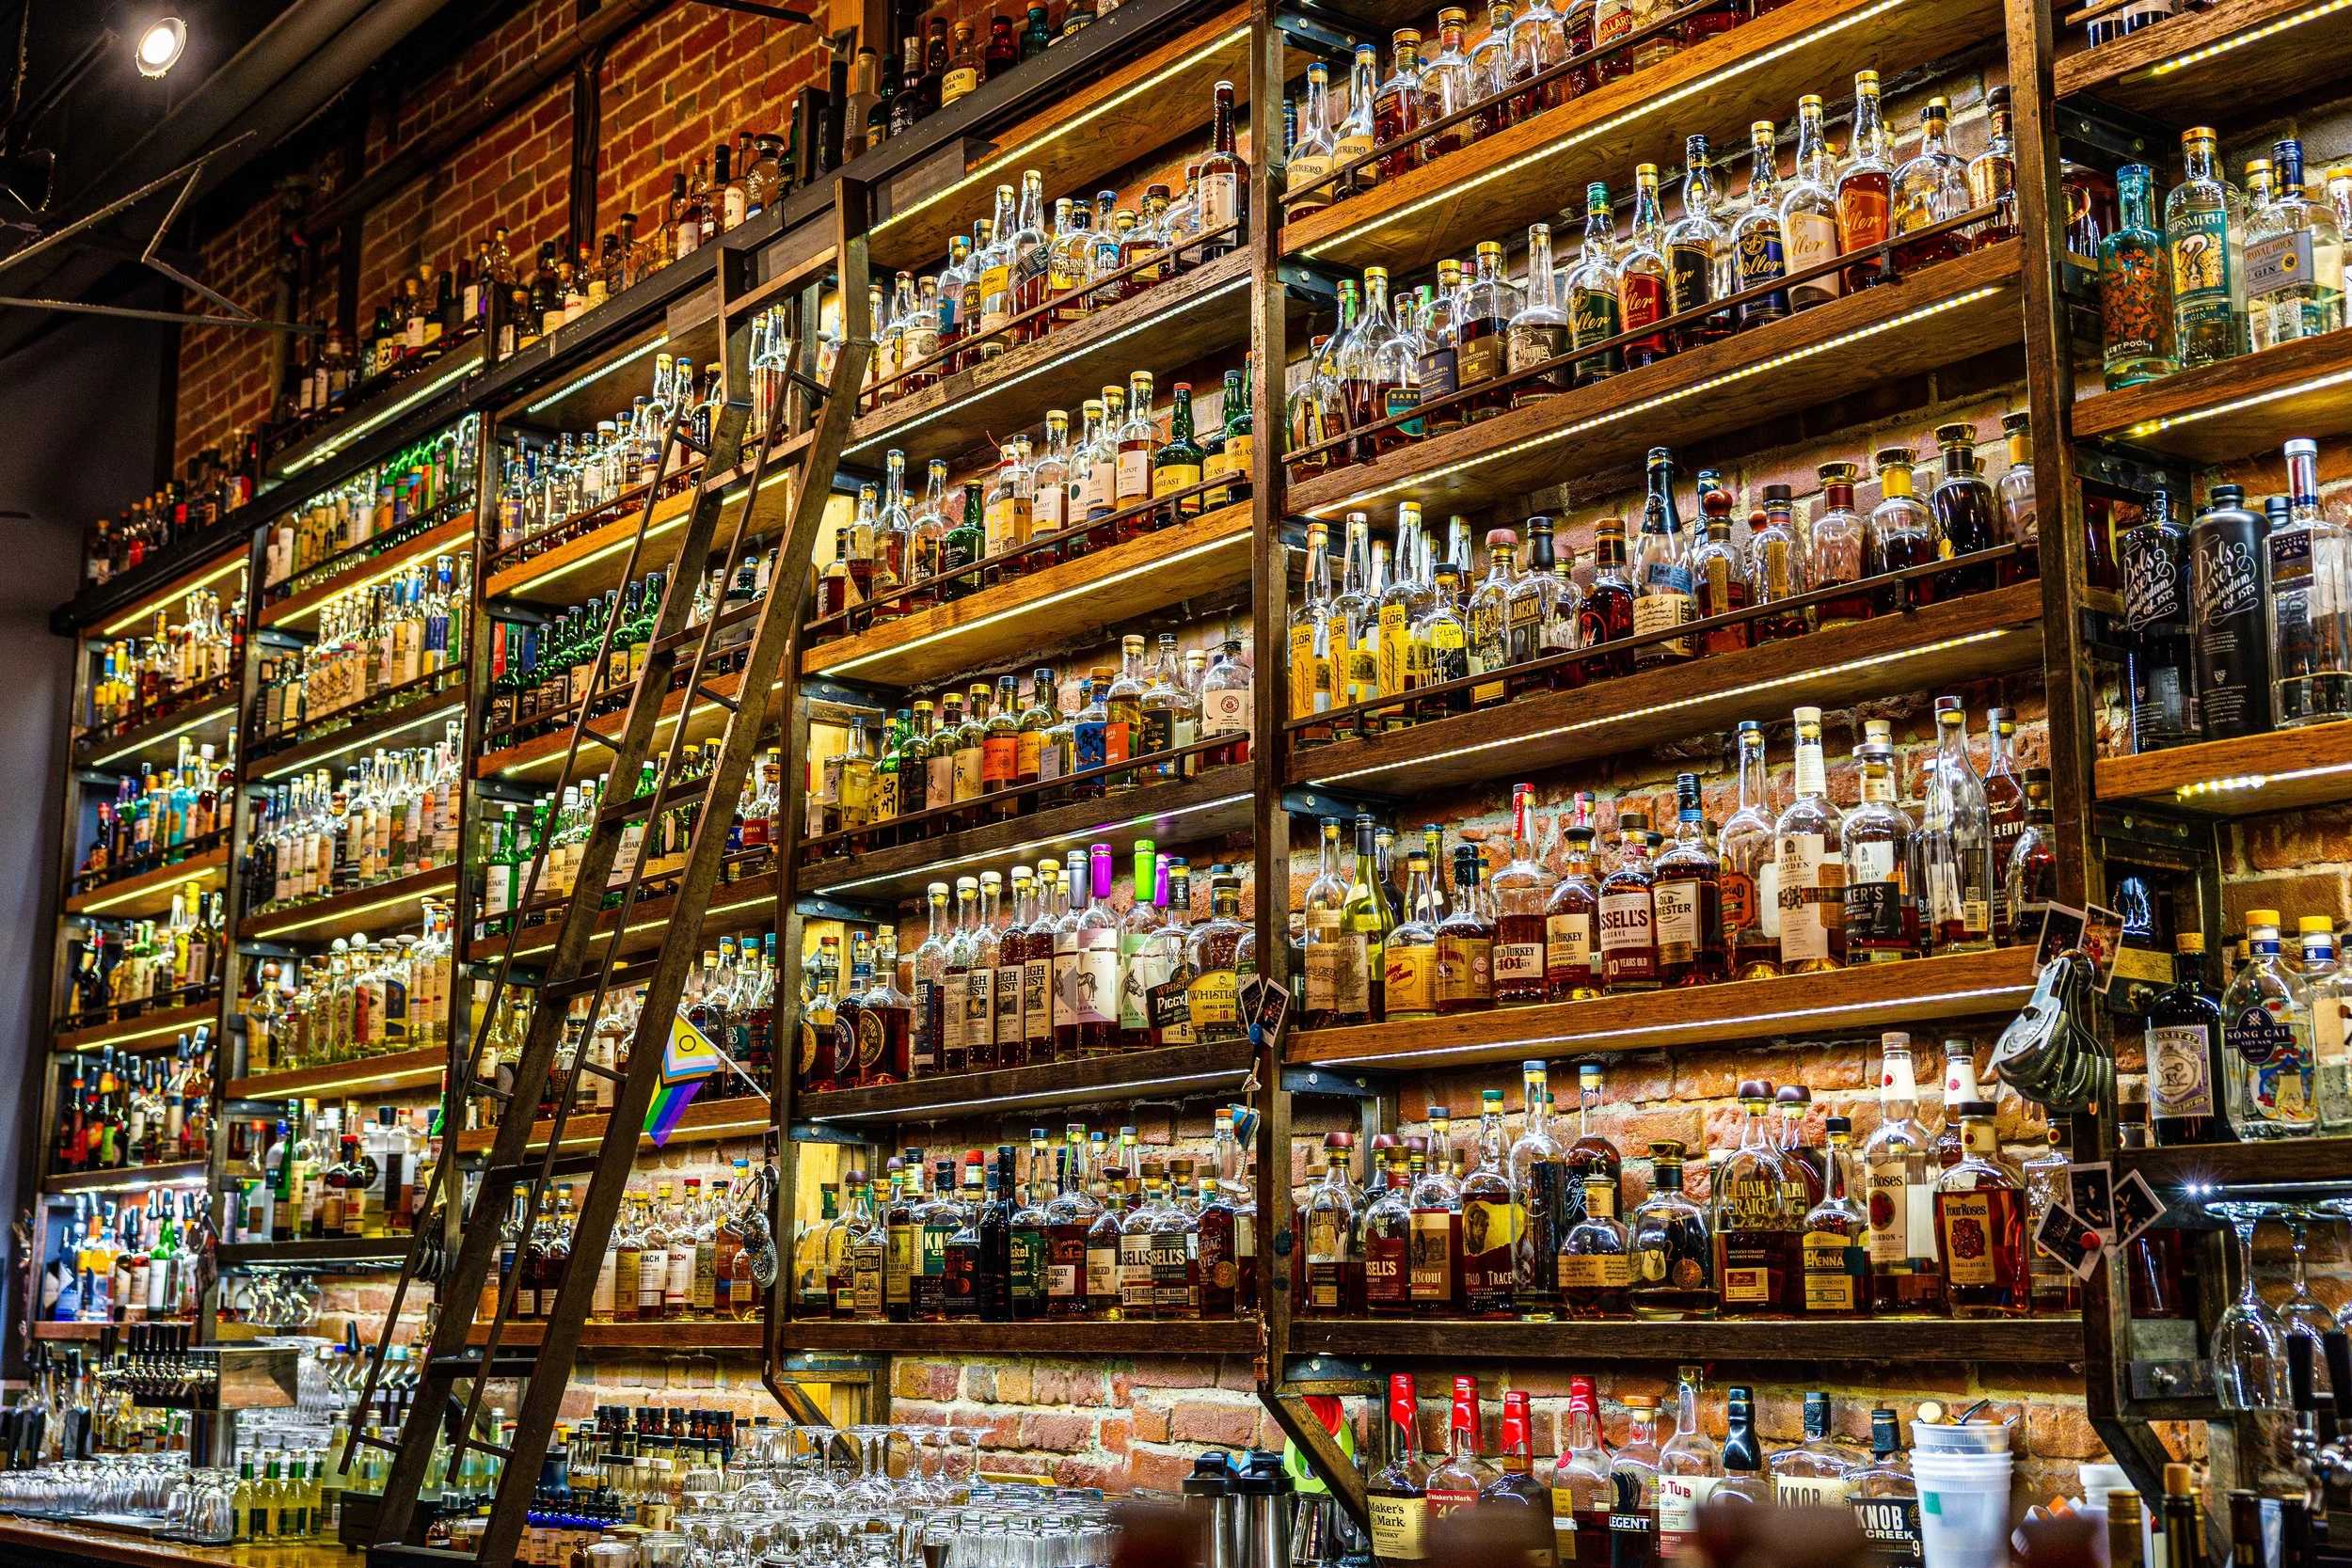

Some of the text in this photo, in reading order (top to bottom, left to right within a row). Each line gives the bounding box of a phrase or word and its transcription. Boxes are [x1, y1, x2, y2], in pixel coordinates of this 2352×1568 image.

[1058, 258, 1086, 270] BERNH
[2254, 265, 2277, 278] GIN
[2123, 341, 2149, 349] POOL
[1421, 366, 1449, 379] ARDSTOWN
[1391, 391, 1420, 400] BARR
[1509, 597, 1539, 621] LARCENY
[882, 777, 897, 815] 白州
[2002, 821, 2026, 836] ENVY
[1177, 888, 1184, 898] 6
[1659, 895, 1674, 906] OLD
[1873, 902, 1883, 923] 7
[1555, 931, 1582, 942] TURKEY
[1505, 945, 1535, 957] TURKEY
[1499, 957, 1521, 971] 101
[1608, 957, 1647, 976] 10 YEARS OLD
[1219, 1009, 1229, 1020] 10
[1181, 1023, 1187, 1036] 6
[2185, 1032, 2198, 1042] 47
[1873, 1173, 1903, 1188] Roses
[1724, 1180, 1766, 1197] ELIJAH
[1725, 1199, 1766, 1217] CRAIG
[1946, 1203, 1987, 1216] Four Roses
[1416, 1271, 1442, 1284] Scout
[1487, 1271, 1513, 1286] TRACE
[1123, 1288, 1130, 1301] 6
[1668, 1481, 1692, 1498] TUB
[1779, 1486, 1821, 1505] KNOB
[1431, 1493, 1454, 1501] Maker's
[1368, 1502, 1405, 1514] Maker's
[1856, 1505, 1904, 1528] KNOB
[1375, 1530, 1400, 1539] WHISKY
[1866, 1529, 1915, 1540] CREEK
[1913, 1540, 1920, 1558] 9
